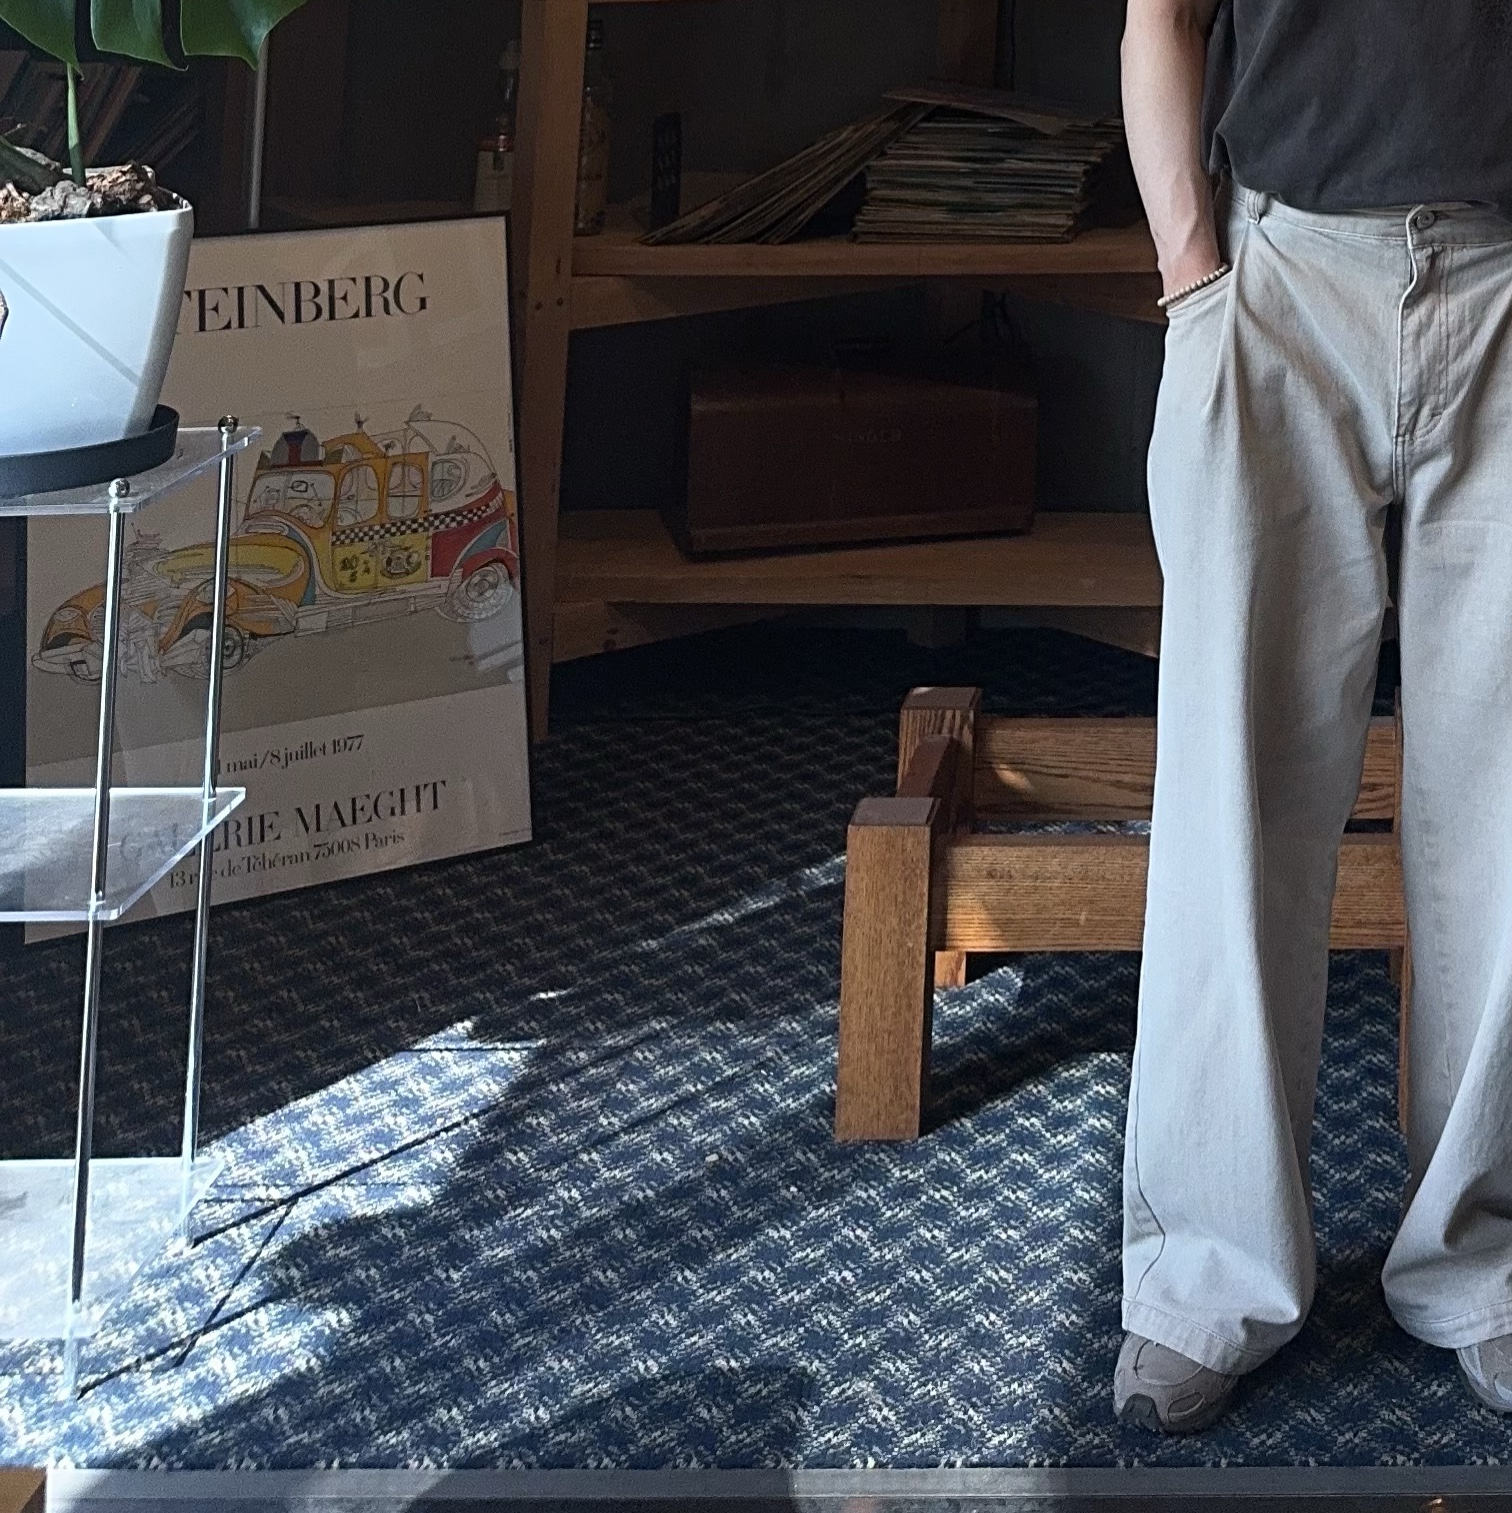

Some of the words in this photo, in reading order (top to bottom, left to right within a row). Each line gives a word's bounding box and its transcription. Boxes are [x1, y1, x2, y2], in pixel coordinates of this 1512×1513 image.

[178, 271, 430, 334] EINBERG
[281, 741, 326, 769] juillet
[332, 734, 366, 754] 1977
[295, 780, 447, 834] MAEGHT
[313, 839, 361, 861] 75008
[364, 829, 405, 851] Paris
